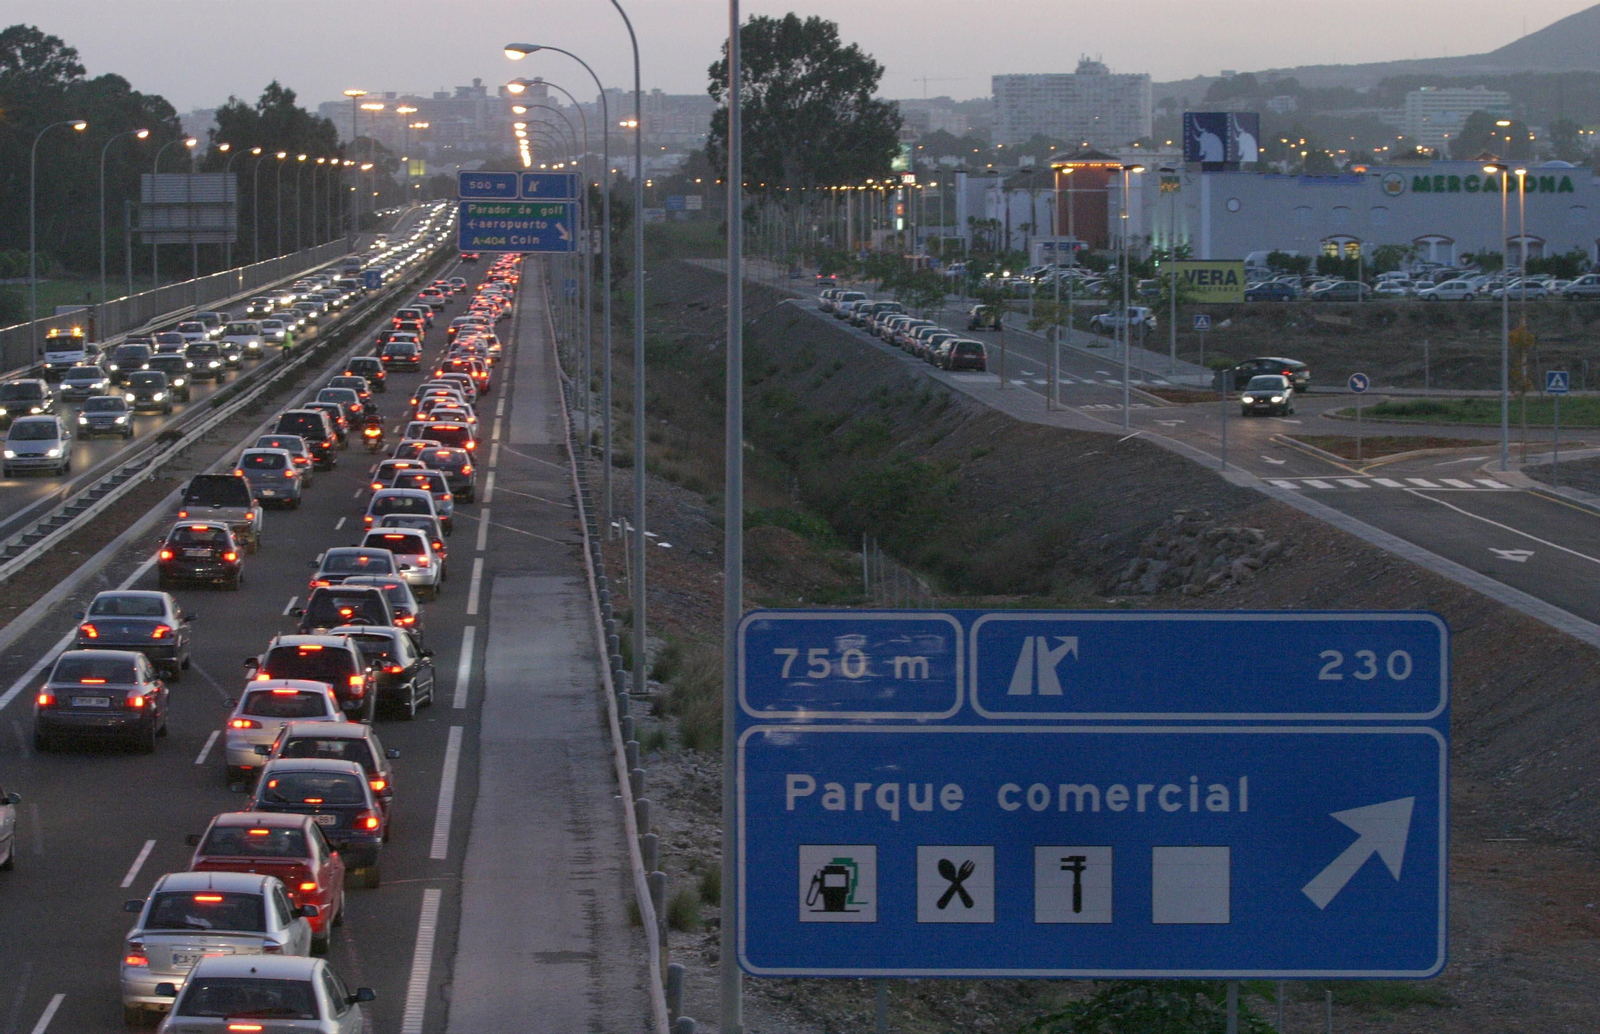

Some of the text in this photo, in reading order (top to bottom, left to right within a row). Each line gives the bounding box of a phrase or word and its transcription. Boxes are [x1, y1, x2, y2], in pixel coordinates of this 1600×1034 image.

[469, 181, 506, 190] 500 m
[1412, 174, 1574, 193] MERCADONA
[468, 204, 564, 217] Parador de golf
[479, 220, 548, 230] aeropuerto
[472, 236, 506, 245] A-404
[1184, 269, 1238, 285] VERA
[773, 648, 929, 679] 750 m
[1318, 649, 1413, 680] 230
[785, 774, 1248, 822] Parque comercial
